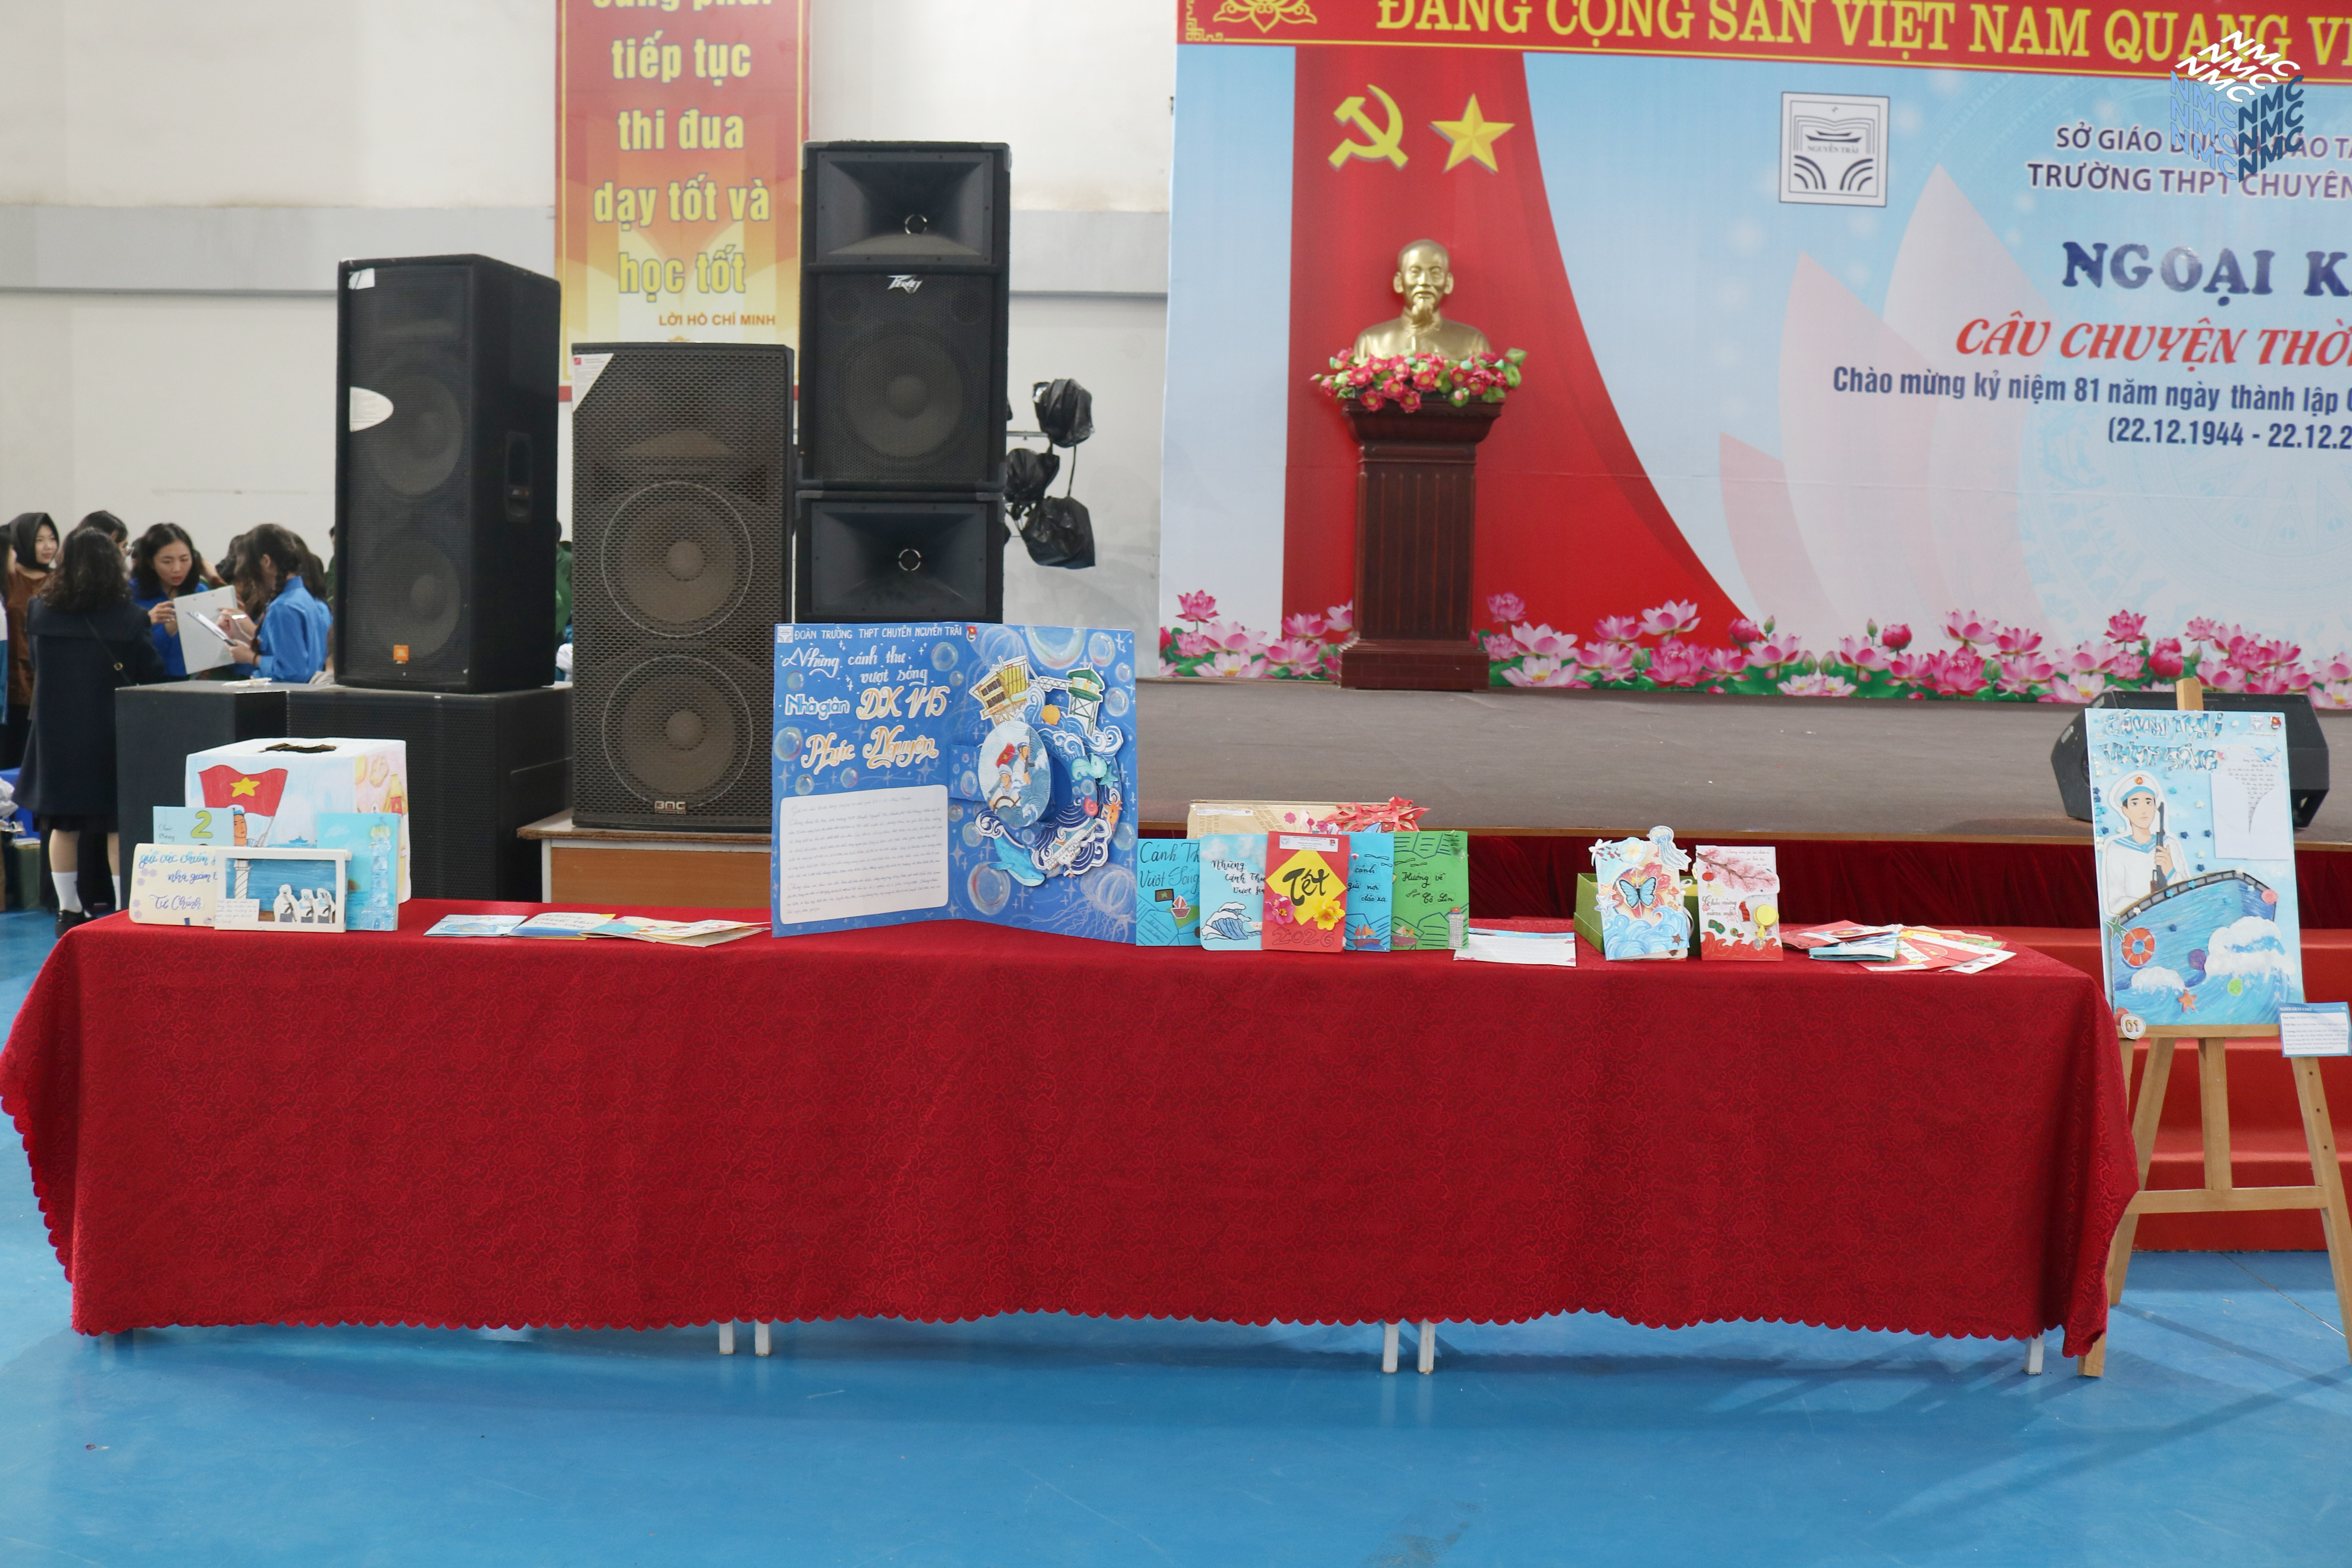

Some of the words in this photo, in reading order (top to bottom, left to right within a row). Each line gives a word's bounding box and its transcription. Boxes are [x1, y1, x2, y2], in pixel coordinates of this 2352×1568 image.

[1969, 4, 2091, 57] NAM
[2104, 9, 2292, 65] QUANG
[611, 29, 682, 83] tiếp
[693, 38, 752, 87] tục
[618, 108, 666, 151] thi
[678, 108, 745, 150] đua
[2056, 122, 2092, 148] SỞ
[2098, 125, 2162, 151] GIÁO
[2028, 158, 2151, 191] TRƯỜNG
[2160, 169, 2229, 194] THPT
[593, 181, 657, 232] dạy
[668, 173, 717, 222] tốt
[728, 178, 770, 221] và
[619, 252, 685, 303] học
[696, 245, 746, 294] tốt
[2062, 241, 2275, 306] NGOẠI
[2304, 251, 2352, 297] K
[659, 312, 682, 325] LỜI
[712, 311, 736, 325] CHÍ
[740, 315, 775, 325] MINH
[1956, 310, 2051, 356] CÂU
[2060, 318, 2247, 372] CHUYỆN
[2257, 319, 2352, 367] THỜ
[1833, 366, 1893, 393] Chào
[1900, 368, 1965, 399] mừng
[1974, 370, 2000, 401] kỷ
[2009, 374, 2066, 404] niệm
[2074, 377, 2099, 402] 81
[2108, 378, 2156, 405] năm
[2165, 381, 2220, 411] ngày
[2231, 385, 2294, 412] thành
[2304, 387, 2338, 416] lập
[2108, 417, 2243, 446] (22.12.1944
[794, 628, 817, 640] ĐOÀN
[821, 627, 853, 639] TRƯỜNG
[858, 628, 879, 639] THPT
[882, 625, 912, 638] CHUYÊN
[915, 623, 942, 637] NGUYỄN
[945, 624, 962, 636] TRÃI
[848, 645, 878, 665] cánh
[800, 732, 856, 775] Phúc
[191, 810, 213, 838] 2
[1140, 842, 1177, 863] Cánh
[1181, 842, 1200, 862] Th
[1355, 864, 1376, 873] cánh
[1283, 868, 1330, 906] Tết
[1272, 926, 1335, 947] 2026
[2125, 1019, 2139, 1032] 01
